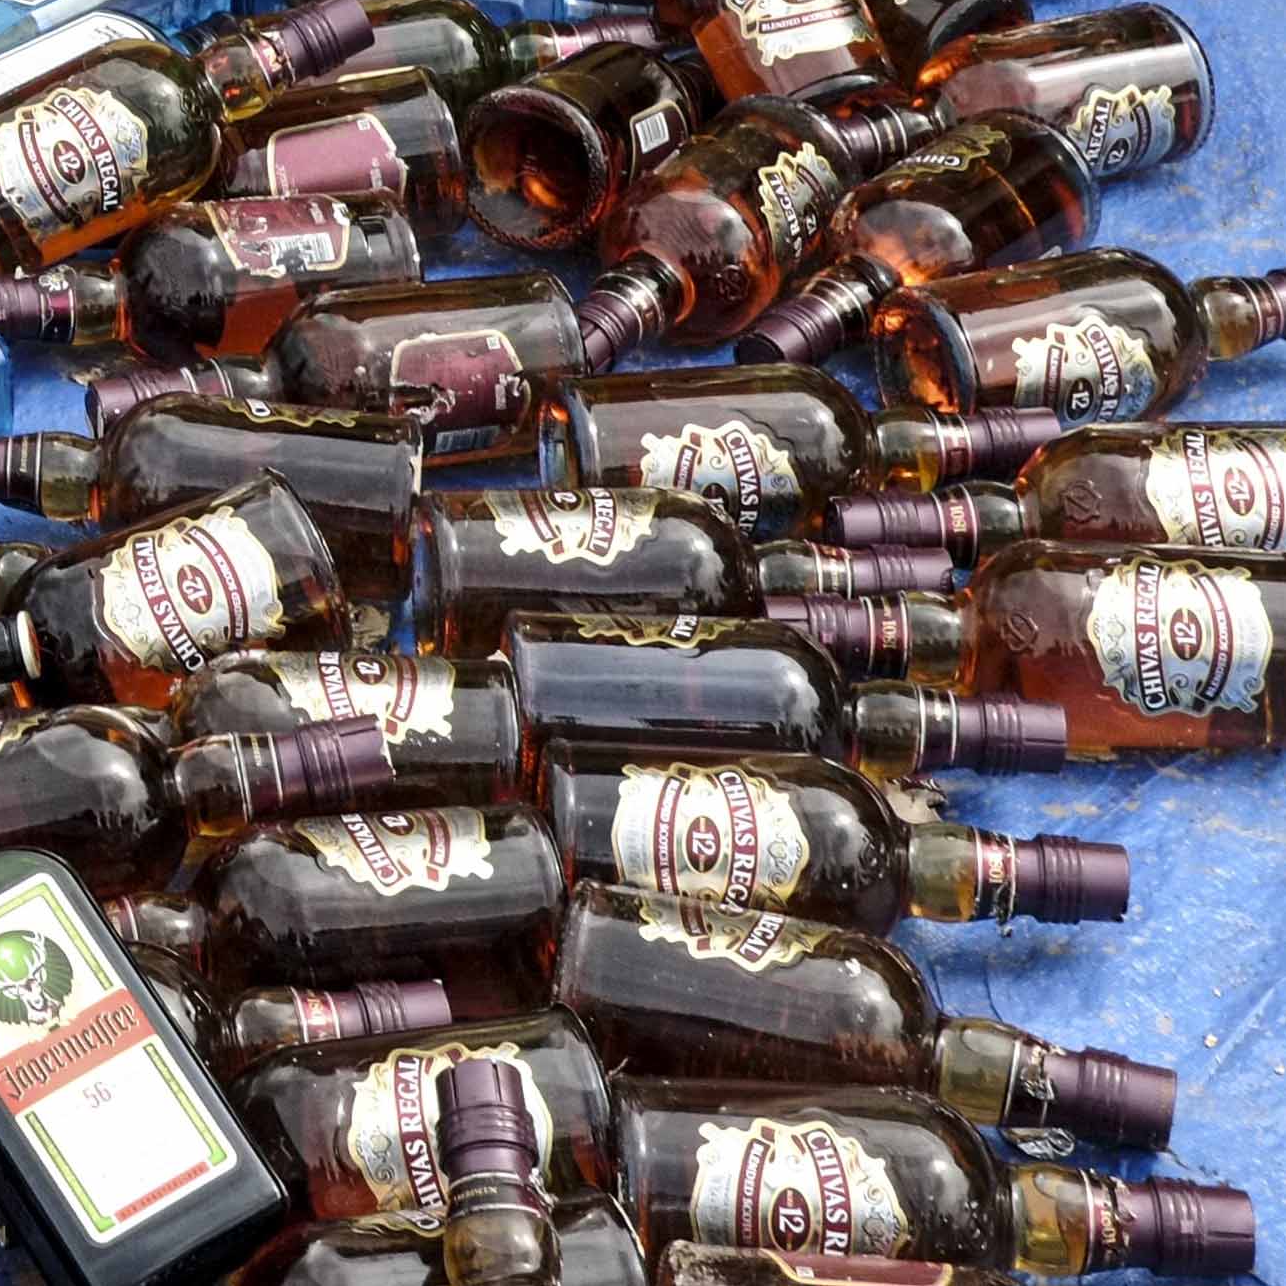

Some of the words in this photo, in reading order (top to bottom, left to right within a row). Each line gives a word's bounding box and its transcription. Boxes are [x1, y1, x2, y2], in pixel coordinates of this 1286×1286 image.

[54, 95, 105, 150] CHIVAS
[95, 150, 120, 211] REGAL
[1088, 101, 1110, 160] REGAL
[1107, 147, 1125, 167] 12
[59, 151, 81, 175] 12
[1086, 324, 1120, 396] CHIVAS
[1071, 390, 1091, 411] 12
[727, 432, 761, 506] CHIVAS
[1184, 433, 1208, 483] REGAL
[1227, 473, 1249, 502] 12
[591, 499, 616, 557] REGAL
[134, 537, 163, 598] REGAL
[185, 576, 205, 602] 12
[1136, 564, 1160, 628] REGAL
[153, 602, 205, 673] CHIVAS
[1174, 621, 1196, 646] 12
[1138, 631, 1166, 710] CHIVAS
[719, 771, 756, 847] CHIVAS
[345, 820, 402, 884] CHIVAS
[691, 831, 717, 857] 12
[719, 853, 756, 914] REGA
[81, 1079, 114, 1110] 56
[398, 1056, 423, 1133] REGAL
[404, 1139, 448, 1229] CHIVAS
[807, 1129, 849, 1225] CHIVAS
[778, 1206, 806, 1234] 12
